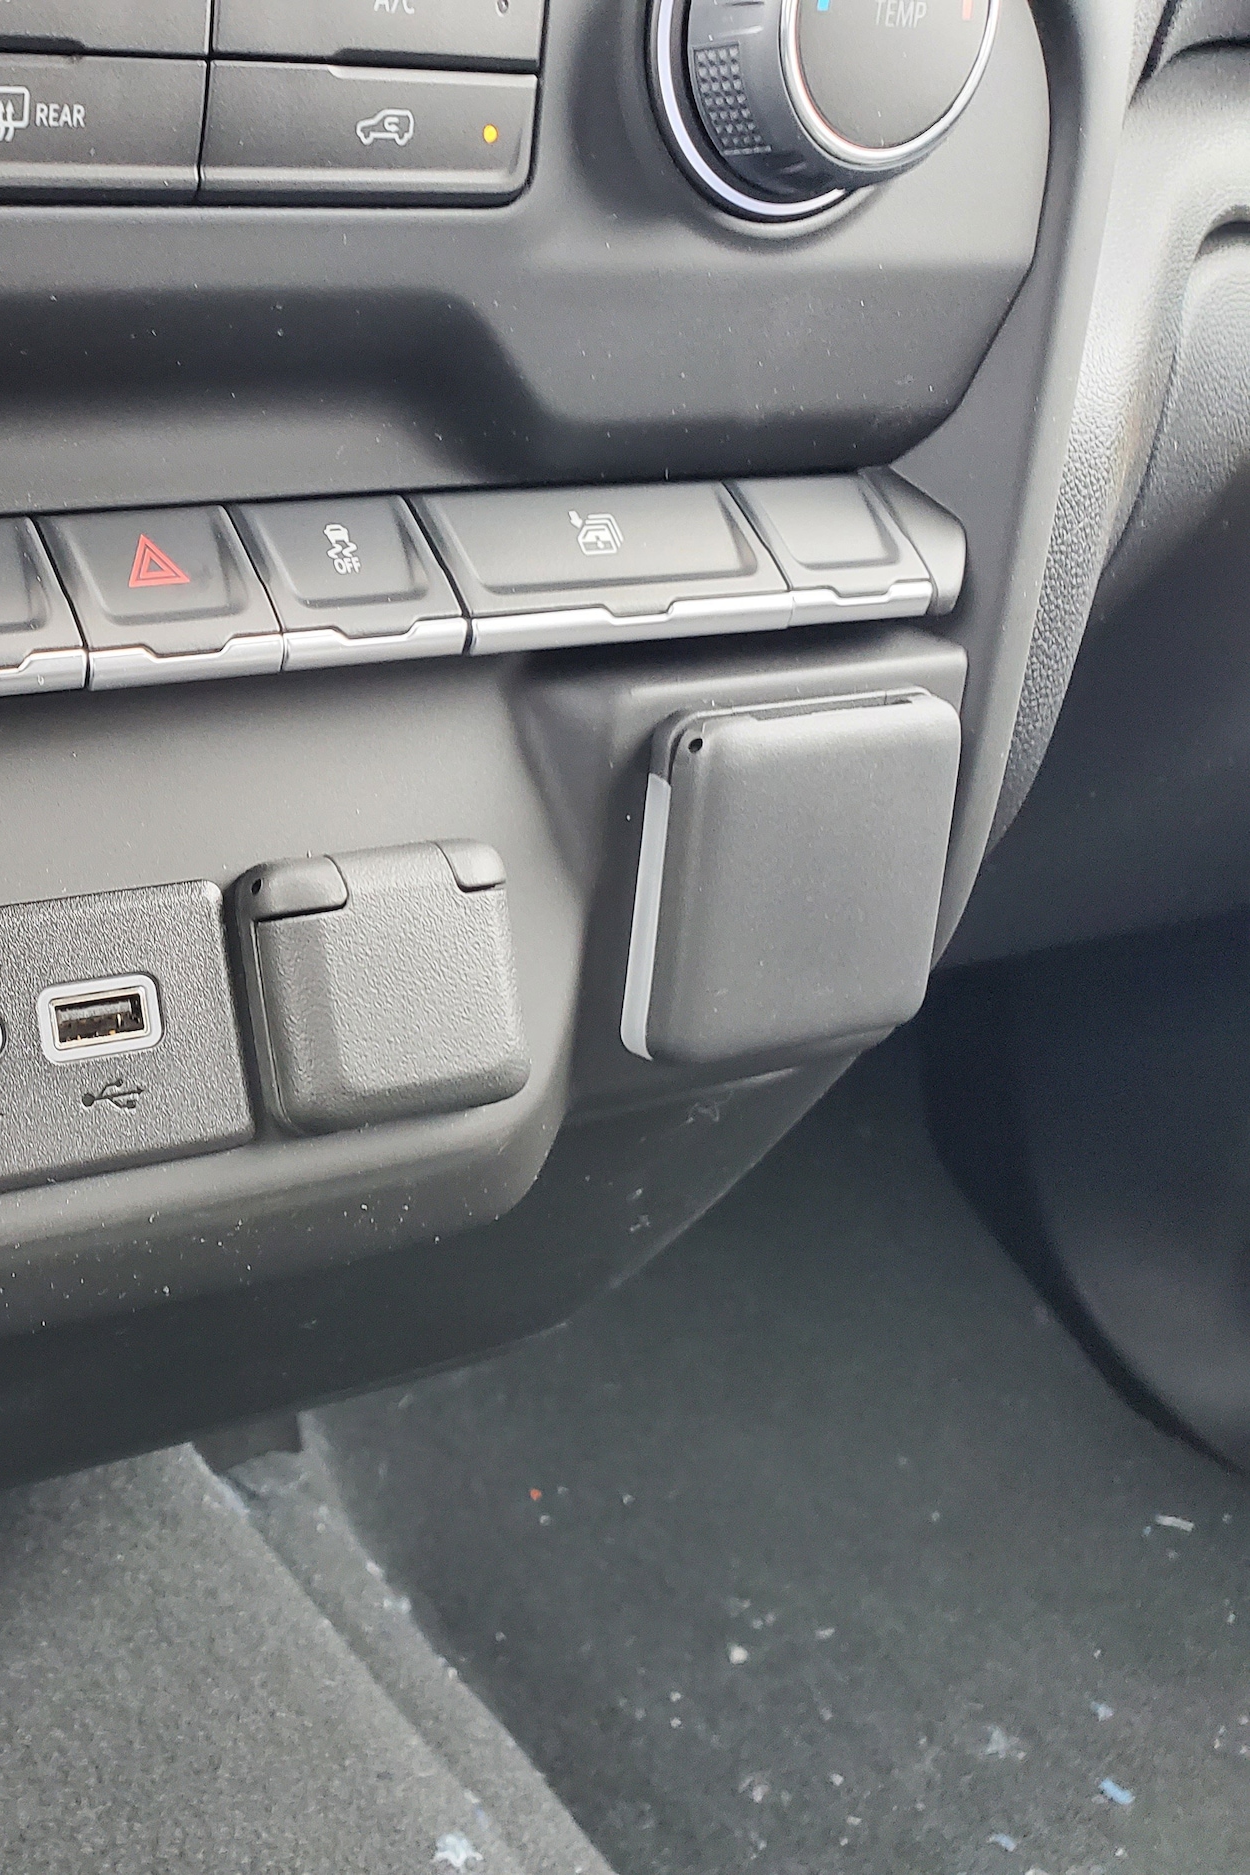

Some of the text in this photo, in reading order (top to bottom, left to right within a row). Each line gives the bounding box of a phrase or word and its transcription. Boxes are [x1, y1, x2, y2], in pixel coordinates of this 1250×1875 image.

[874, 0, 927, 28] TEMP
[35, 102, 86, 128] REAR
[333, 556, 361, 575] OFF
